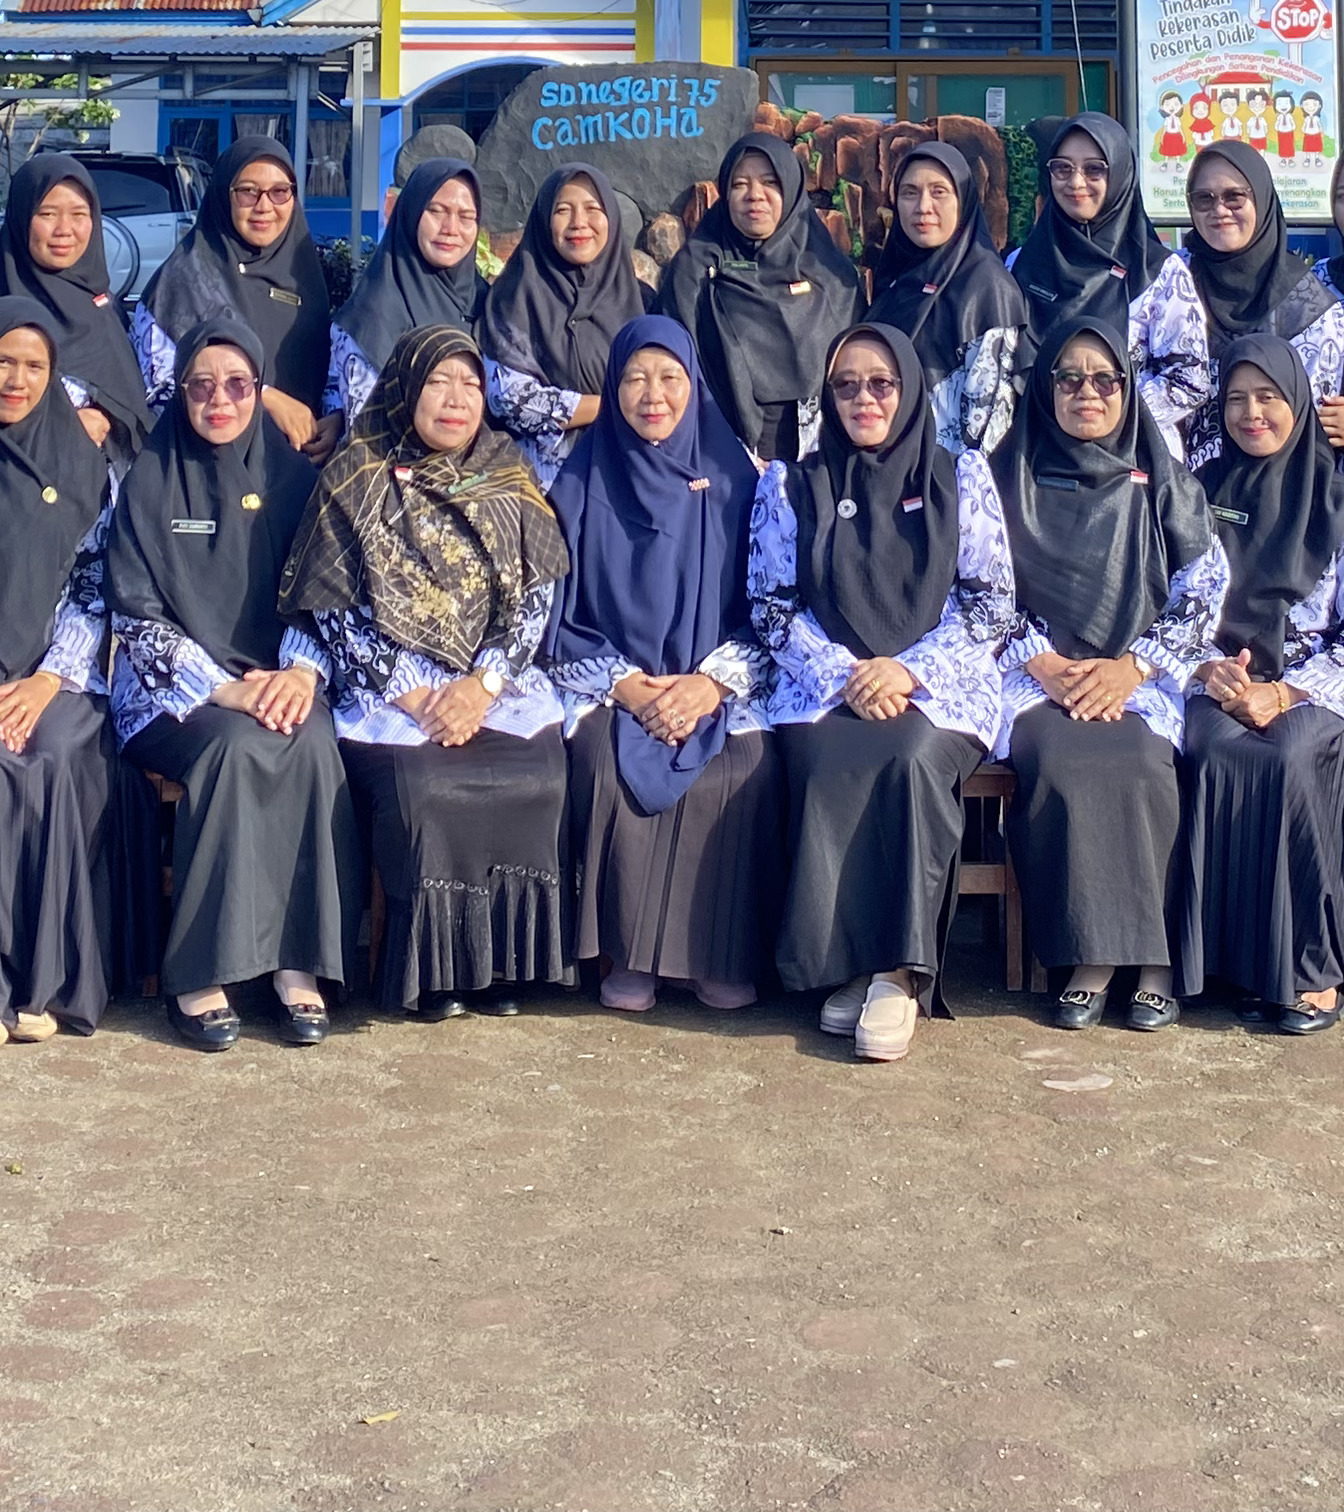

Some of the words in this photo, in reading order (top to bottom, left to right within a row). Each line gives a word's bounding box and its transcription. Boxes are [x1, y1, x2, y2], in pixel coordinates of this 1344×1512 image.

[1159, 9, 1239, 37] Kekerasan
[1150, 36, 1212, 60] Peserta
[1217, 24, 1256, 47] Didik
[1152, 59, 1202, 84] Pencegahan
[1205, 54, 1221, 63] dan
[1224, 52, 1275, 63] Penanganan
[1278, 57, 1322, 83] Kekerasan
[1175, 65, 1225, 83] Dilingkungan
[1229, 63, 1258, 71] Satuan
[1261, 64, 1304, 84] Pendidikan
[683, 78, 721, 107] 75
[1153, 187, 1177, 196] Harus
[1163, 198, 1185, 207] Serta
[1281, 199, 1318, 207] ekerasan
